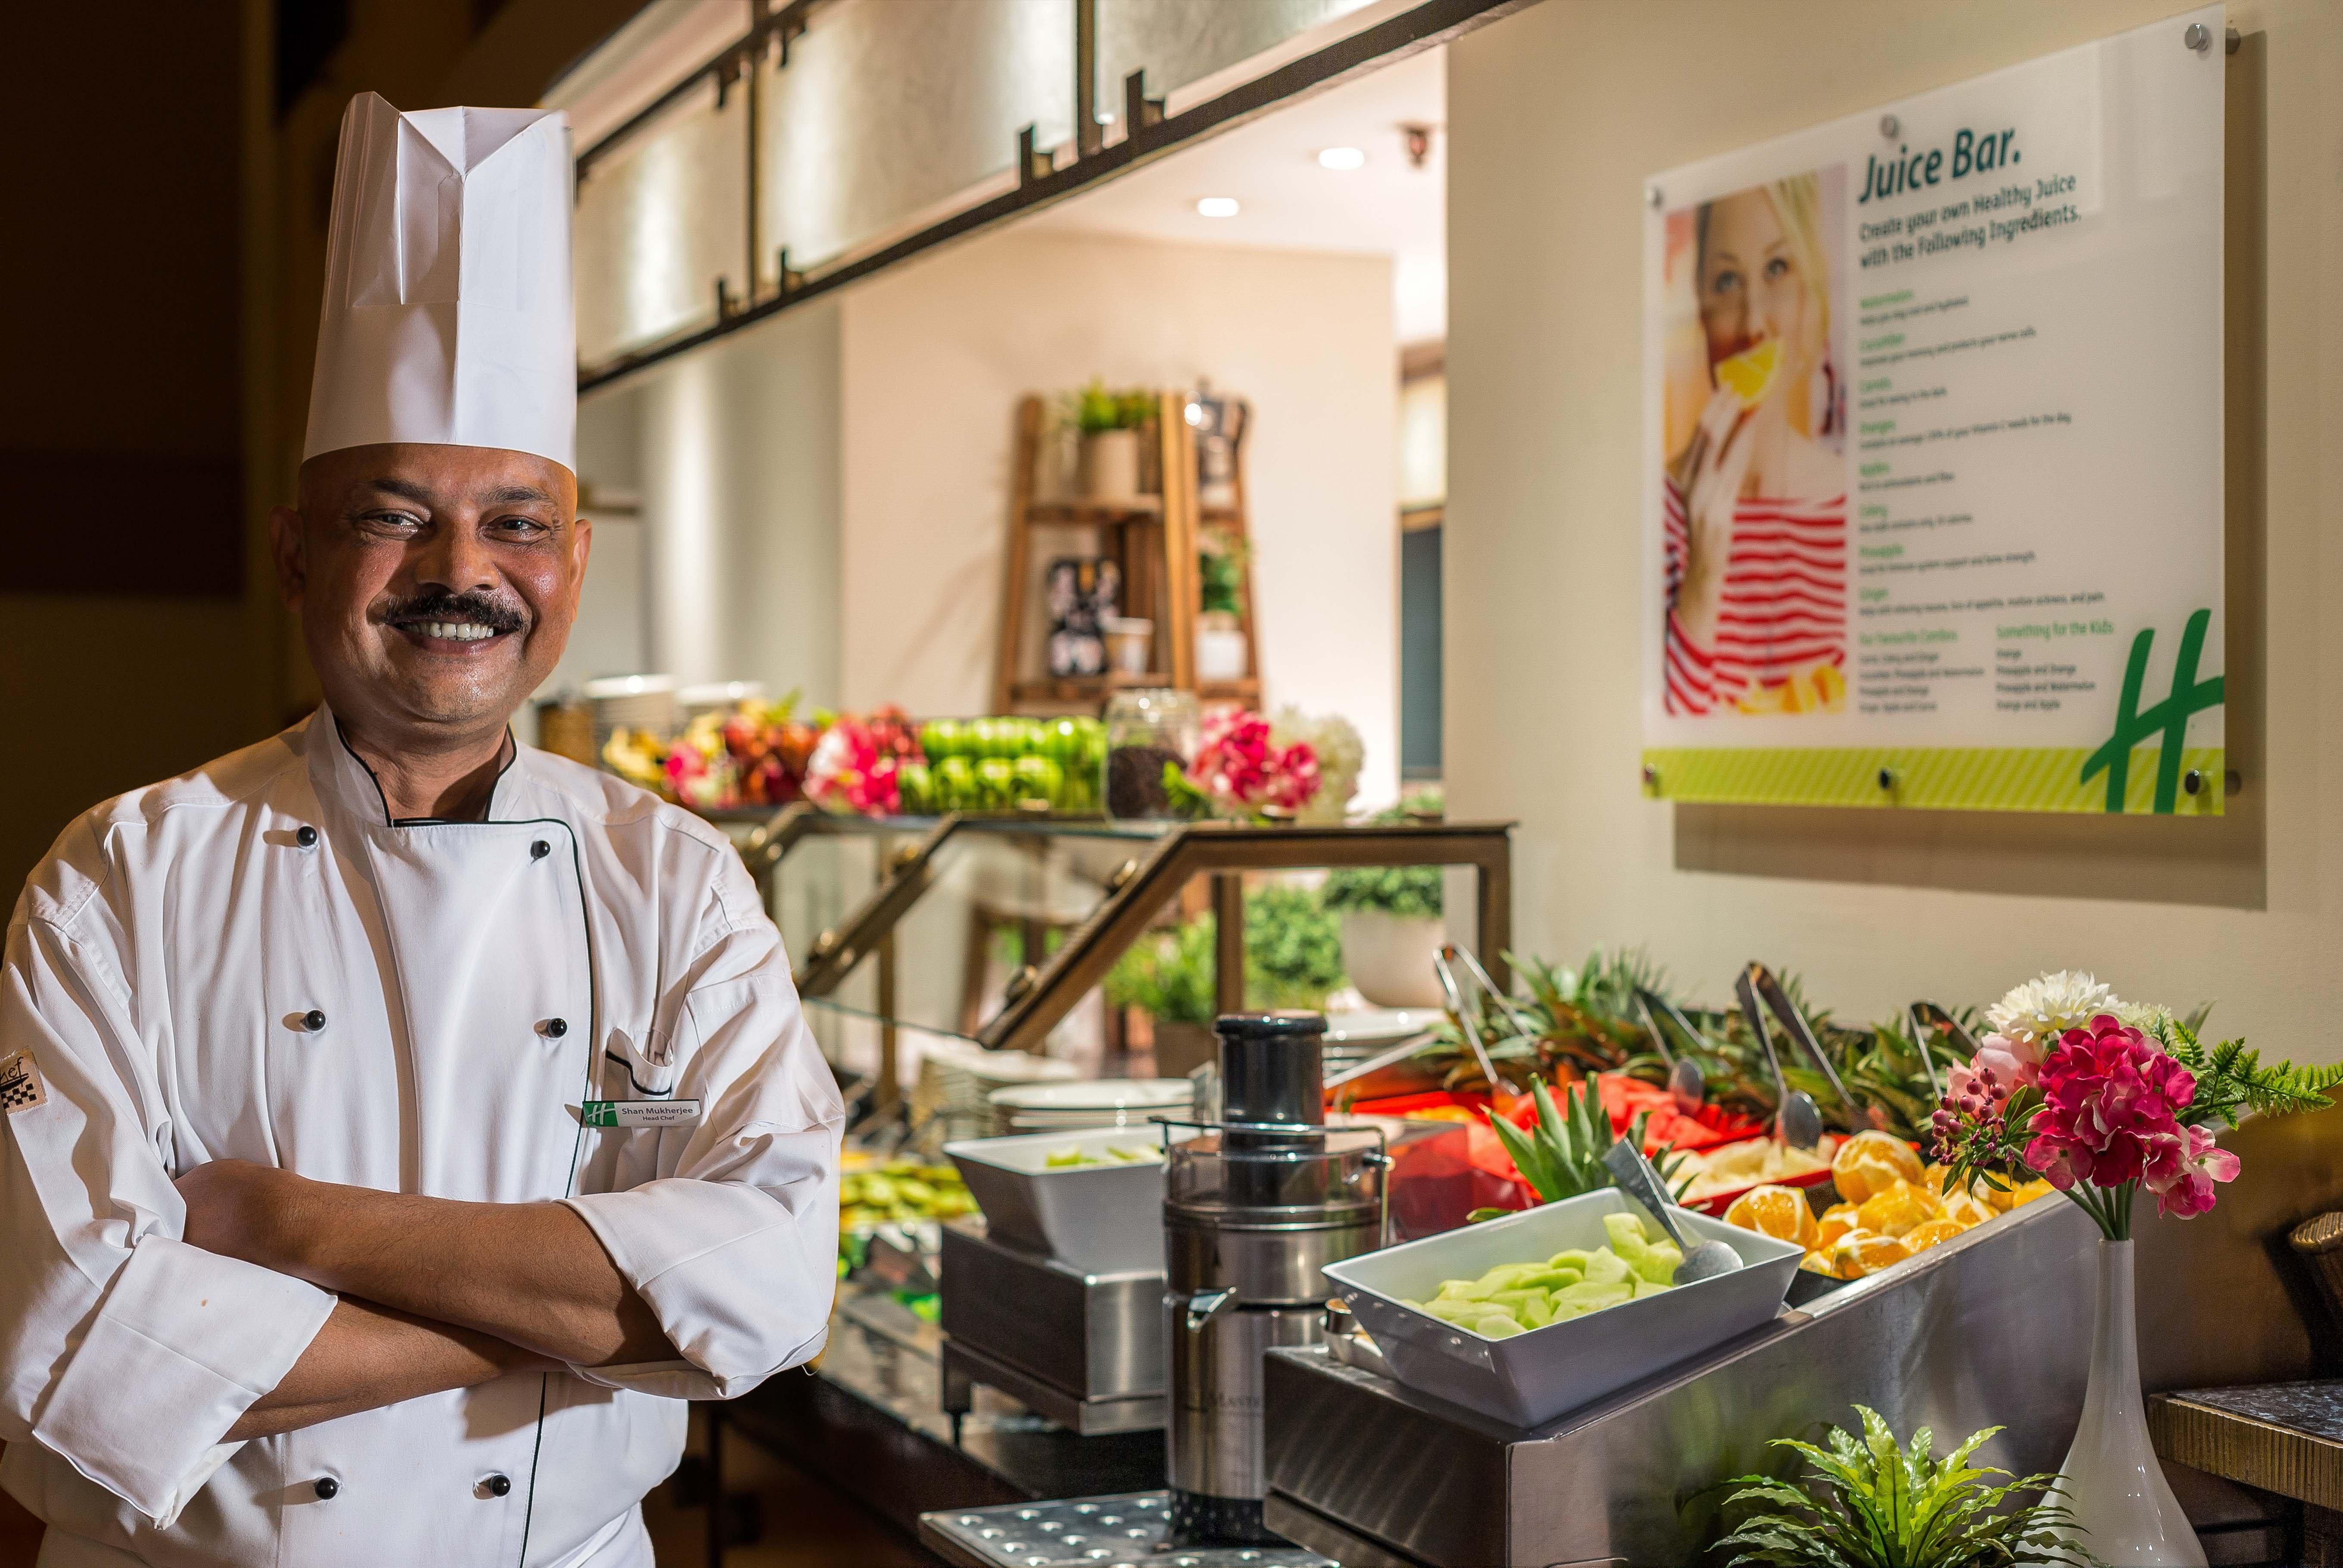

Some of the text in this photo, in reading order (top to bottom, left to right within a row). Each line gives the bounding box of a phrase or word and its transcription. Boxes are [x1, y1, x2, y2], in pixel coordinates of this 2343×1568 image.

[1858, 128, 2021, 204] Juice Bar.
[1859, 174, 2077, 242] Create your own Healthy Juice
[1860, 204, 2082, 268] with the Following Ingredients.
[1995, 619, 2114, 641] Something for the Kids
[646, 1107, 693, 1115] Mukherjee
